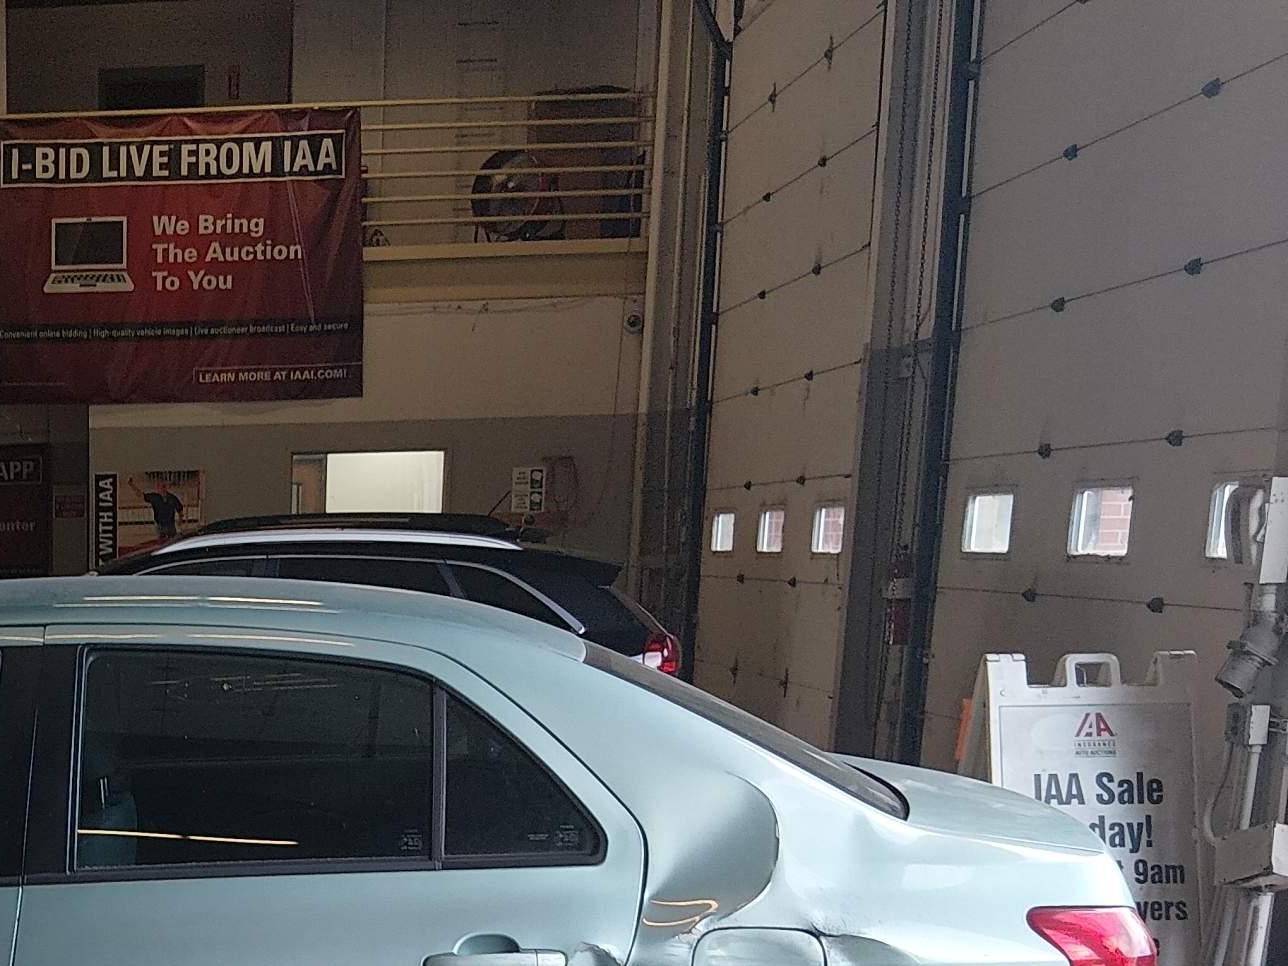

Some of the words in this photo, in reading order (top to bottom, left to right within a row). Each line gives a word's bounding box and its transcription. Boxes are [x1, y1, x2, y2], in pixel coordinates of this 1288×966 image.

[11, 147, 90, 180] I-BID
[102, 144, 170, 178] LIVE
[180, 141, 273, 176] FROM
[283, 138, 338, 173] IAA
[152, 215, 190, 236] We
[198, 213, 265, 237] Bring
[152, 243, 197, 264] The
[205, 240, 304, 263] Auction
[152, 271, 180, 291] To
[187, 269, 233, 291] You
[62, 328, 88, 340] bidding
[136, 327, 162, 338] vehicle
[194, 325, 210, 336] Live
[249, 323, 286, 334] broadcast
[291, 322, 308, 334] Easy
[309, 321, 322, 331] and
[324, 321, 350, 331] secure
[199, 371, 235, 383] LEARN
[238, 370, 272, 382] MORE
[273, 370, 287, 381] AT
[99, 478, 114, 507] IAA
[99, 510, 114, 556] WITH
[1033, 772, 1086, 805] IAA
[1095, 771, 1164, 805] Sale
[1088, 814, 1153, 854] day!
[1133, 858, 1185, 885] 9am
[1135, 900, 1189, 923] yers
